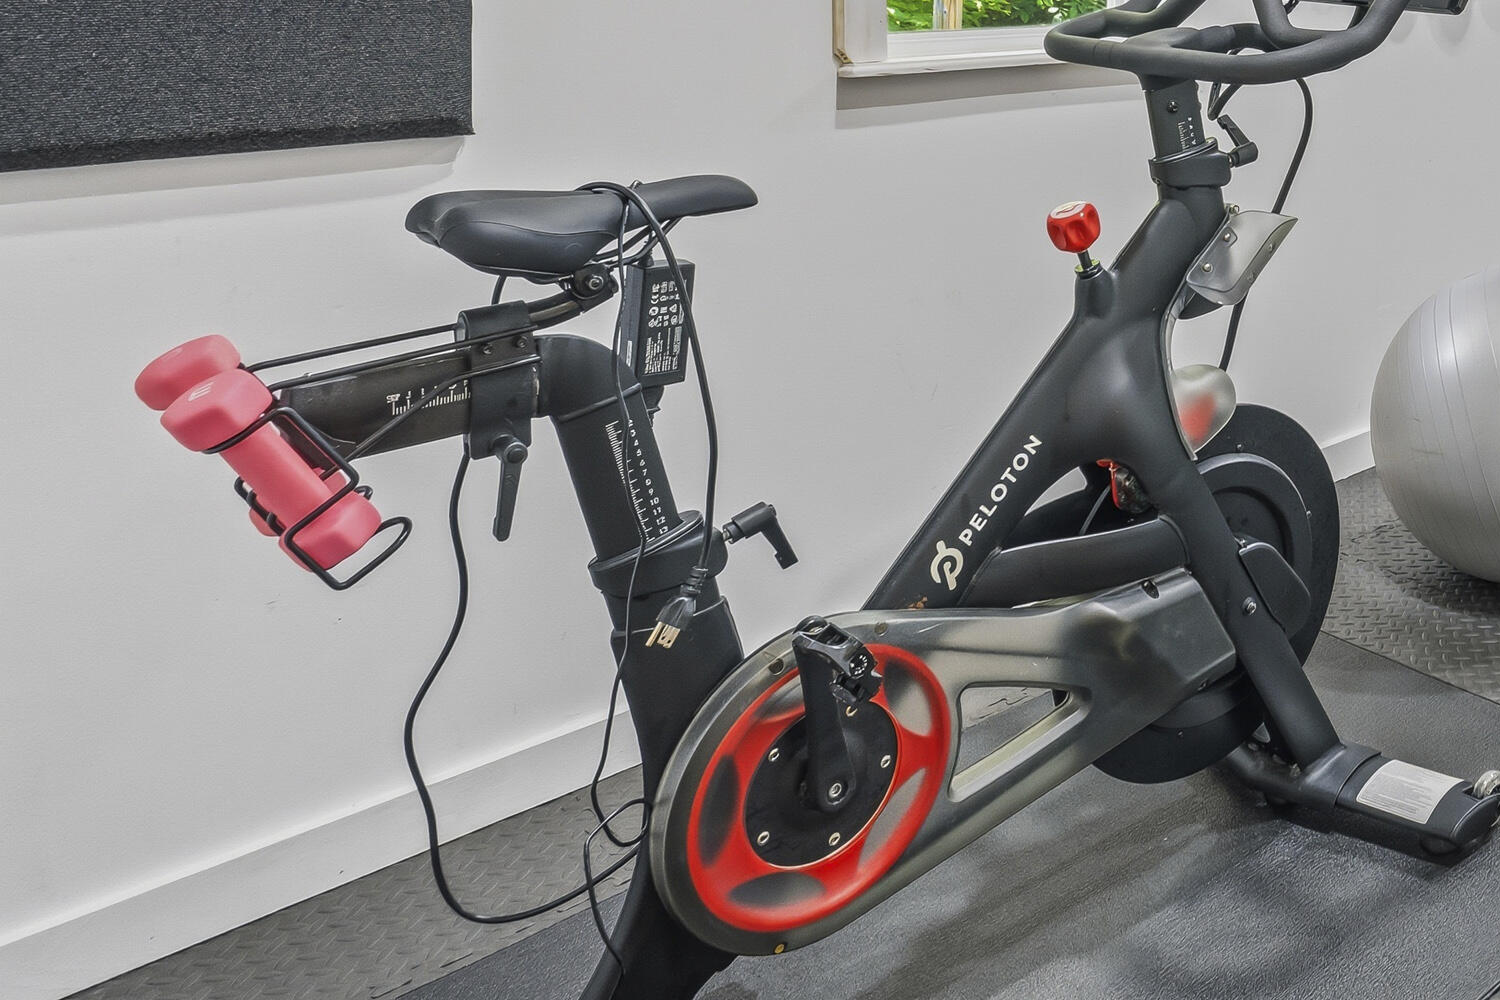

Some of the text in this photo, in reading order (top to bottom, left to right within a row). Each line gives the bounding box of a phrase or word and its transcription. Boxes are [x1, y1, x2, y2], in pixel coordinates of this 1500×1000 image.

[642, 468, 647, 476] 7
[648, 488, 654, 496] 9
[958, 434, 1043, 546] PELOTON
[650, 497, 659, 506] 10
[653, 507, 661, 515] 11
